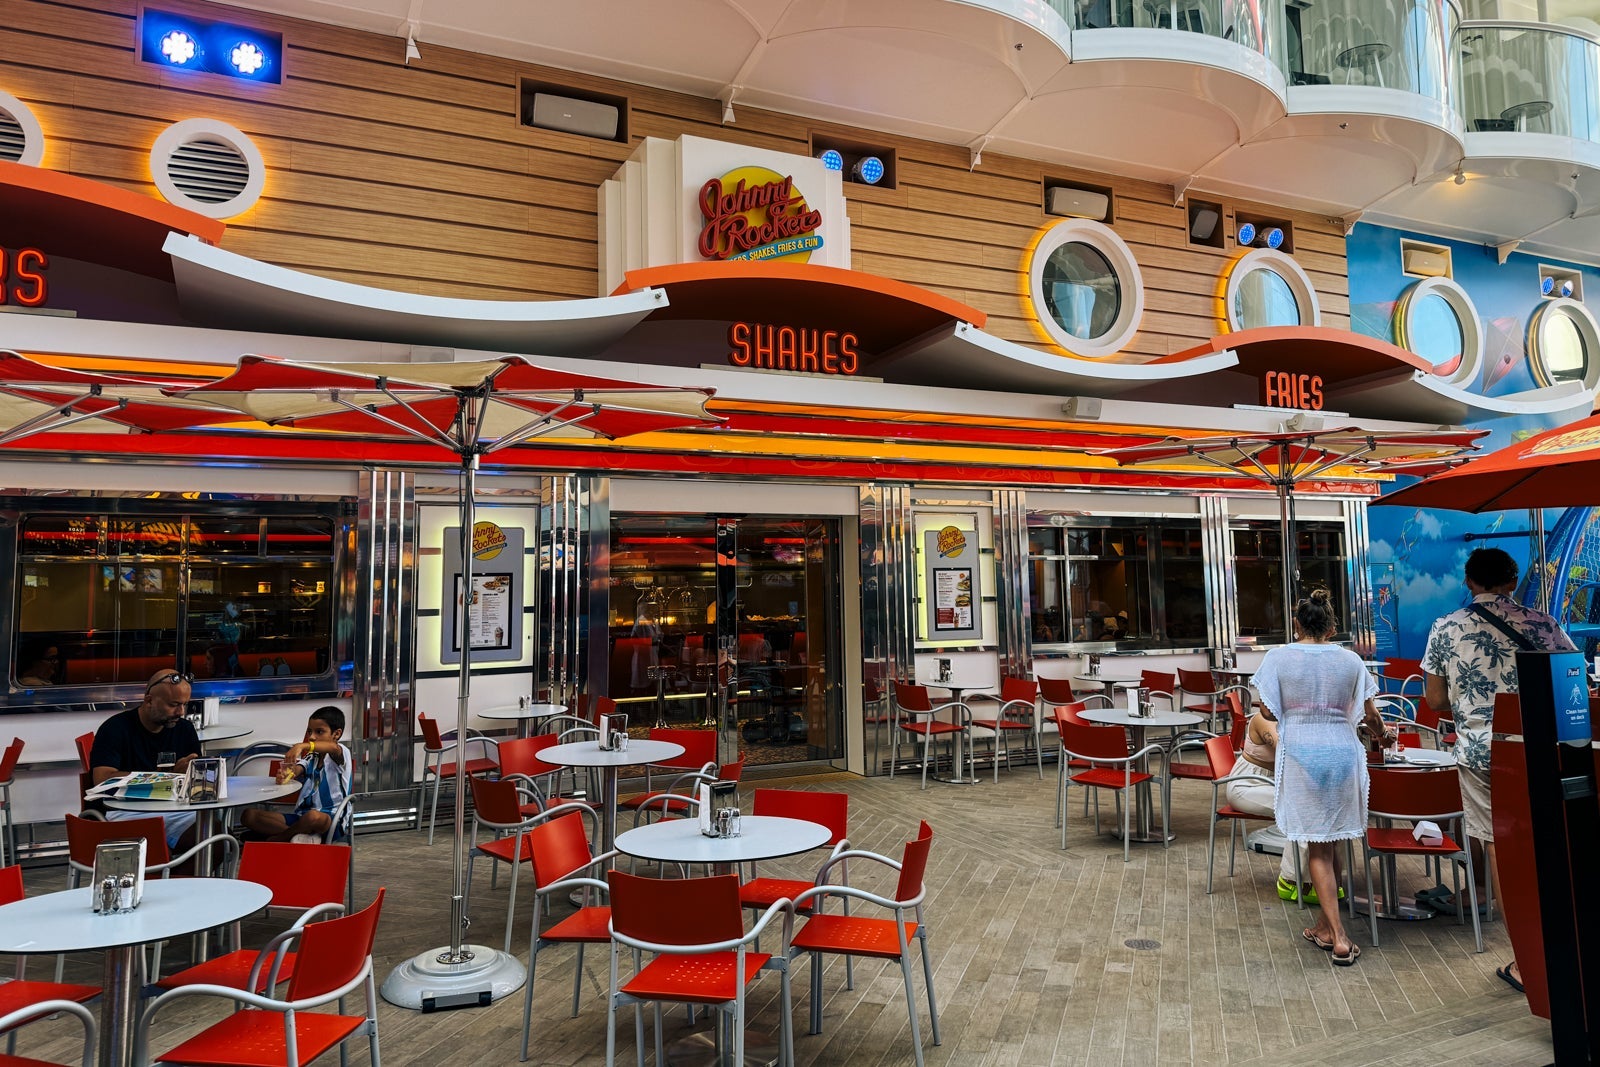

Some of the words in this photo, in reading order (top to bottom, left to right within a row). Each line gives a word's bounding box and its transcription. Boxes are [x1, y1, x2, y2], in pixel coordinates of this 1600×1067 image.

[698, 175, 795, 258] Johnny
[718, 200, 822, 258] Rockets
[777, 241, 796, 253] FRIES
[797, 239, 804, 249] &
[804, 237, 818, 248] FUN
[0, 246, 48, 306] S
[731, 321, 859, 375] SHAKES
[1265, 370, 1324, 410] FRIES
